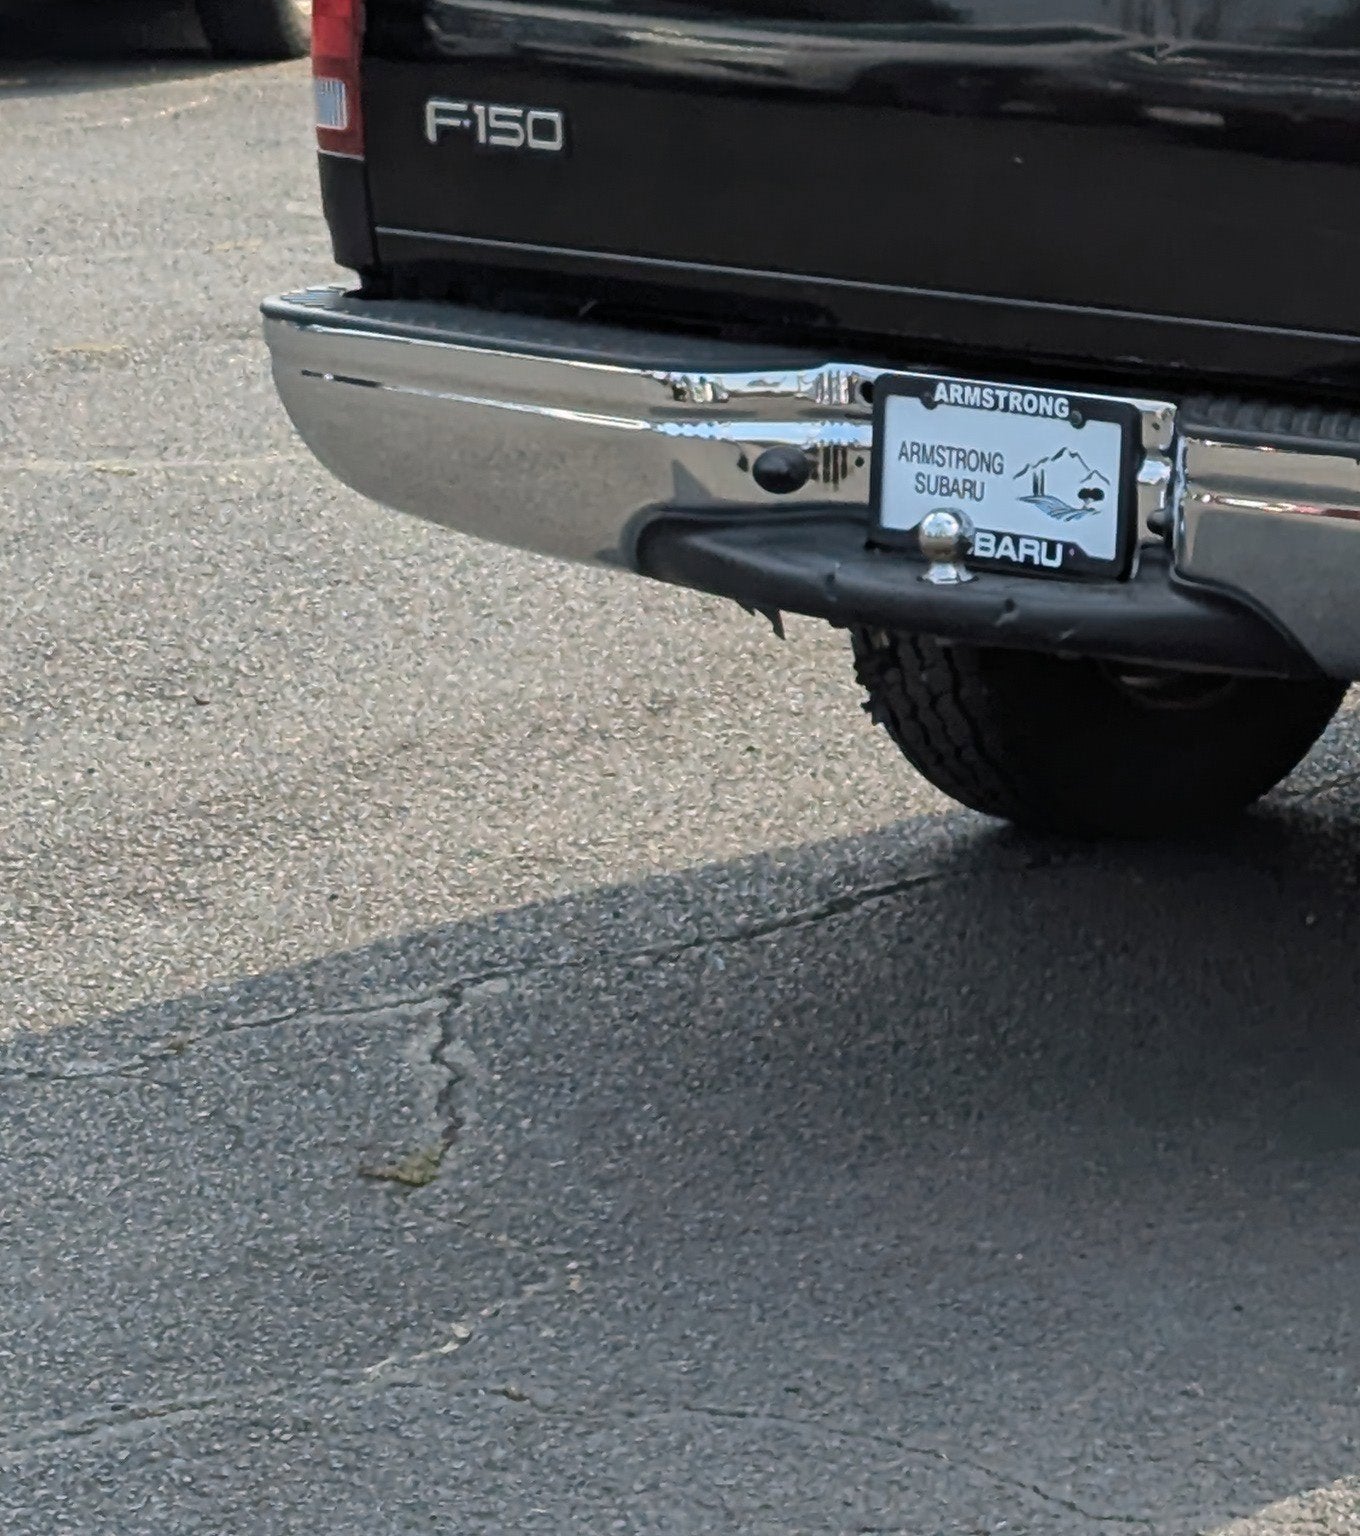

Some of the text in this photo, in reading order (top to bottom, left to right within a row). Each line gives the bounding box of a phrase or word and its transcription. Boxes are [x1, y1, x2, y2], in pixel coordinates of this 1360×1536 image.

[933, 381, 1070, 418] ARMSTRONG
[897, 440, 1005, 475] ARMSTRONG
[914, 471, 986, 502] SUBARU
[967, 531, 1064, 568] BARU
